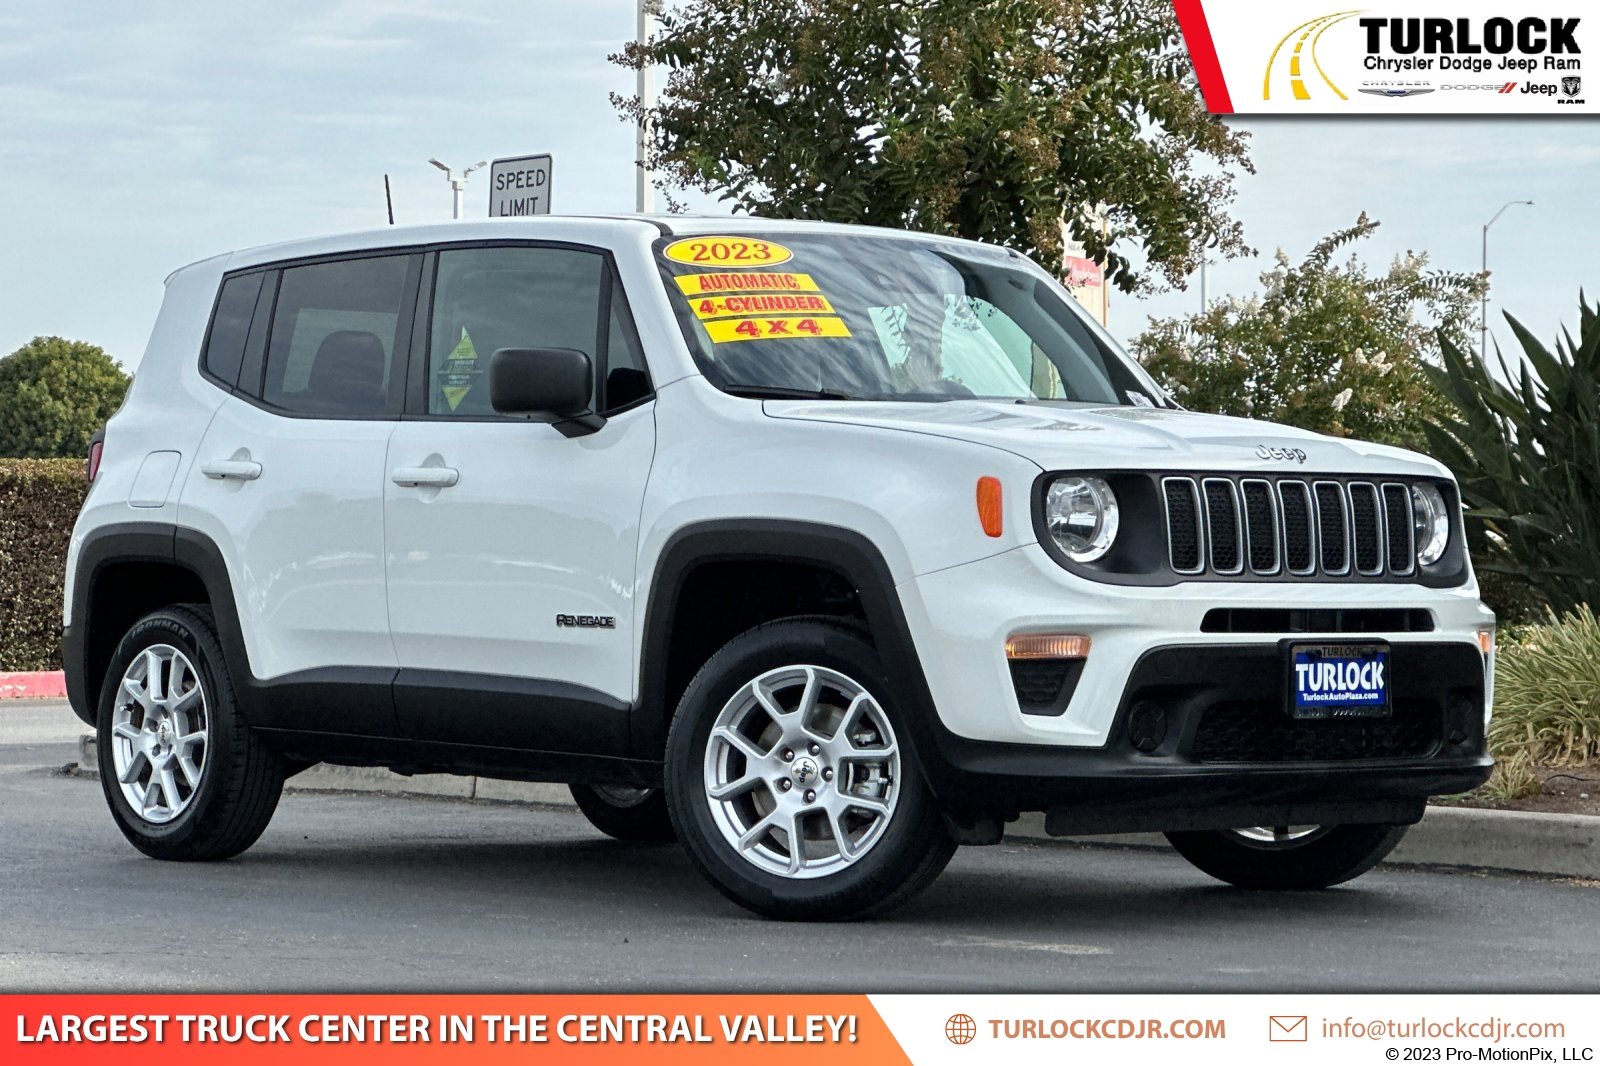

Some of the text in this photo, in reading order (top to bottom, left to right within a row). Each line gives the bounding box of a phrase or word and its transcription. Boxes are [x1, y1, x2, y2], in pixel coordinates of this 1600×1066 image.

[496, 169, 546, 190] SPEED
[501, 196, 538, 217] LIMIT
[690, 242, 771, 261] 2023
[699, 272, 800, 291] AUTOMATIC
[699, 295, 827, 315] 4-CYLINDER
[1255, 444, 1307, 464] Jeep
[556, 614, 616, 629] RENEGADE
[1296, 661, 1385, 692] TURLOCK
[1303, 692, 1379, 701] TurlockAutoPlaza.com
